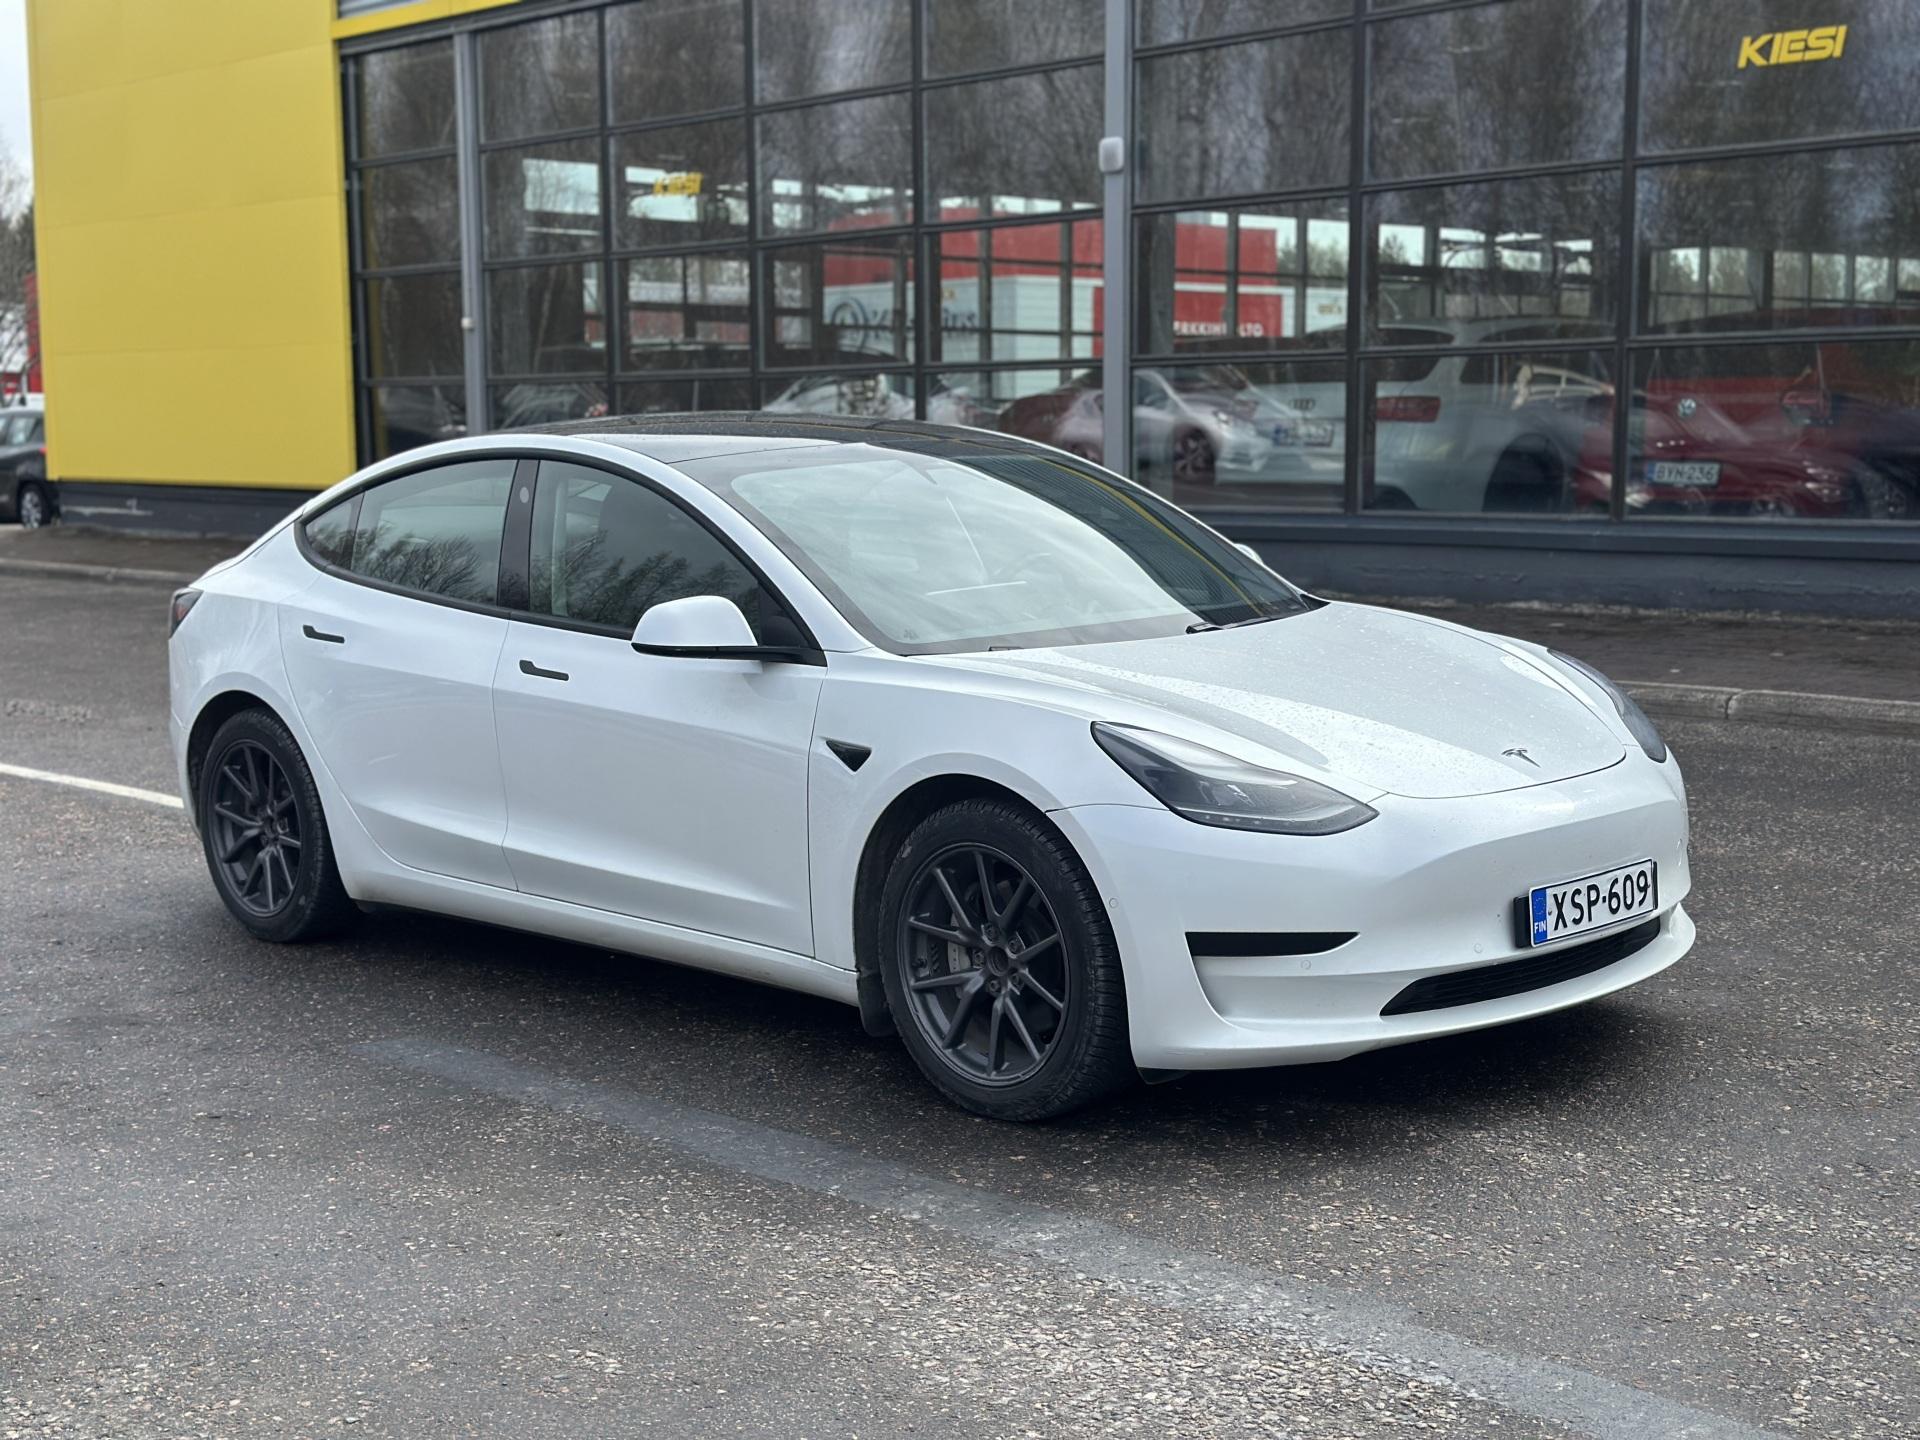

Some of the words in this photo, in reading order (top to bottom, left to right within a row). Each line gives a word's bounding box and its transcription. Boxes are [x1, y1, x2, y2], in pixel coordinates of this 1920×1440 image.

[1737, 24, 1848, 69] KIESI
[1553, 869, 1649, 931] XSP-609
[1534, 920, 1547, 934] FIN
